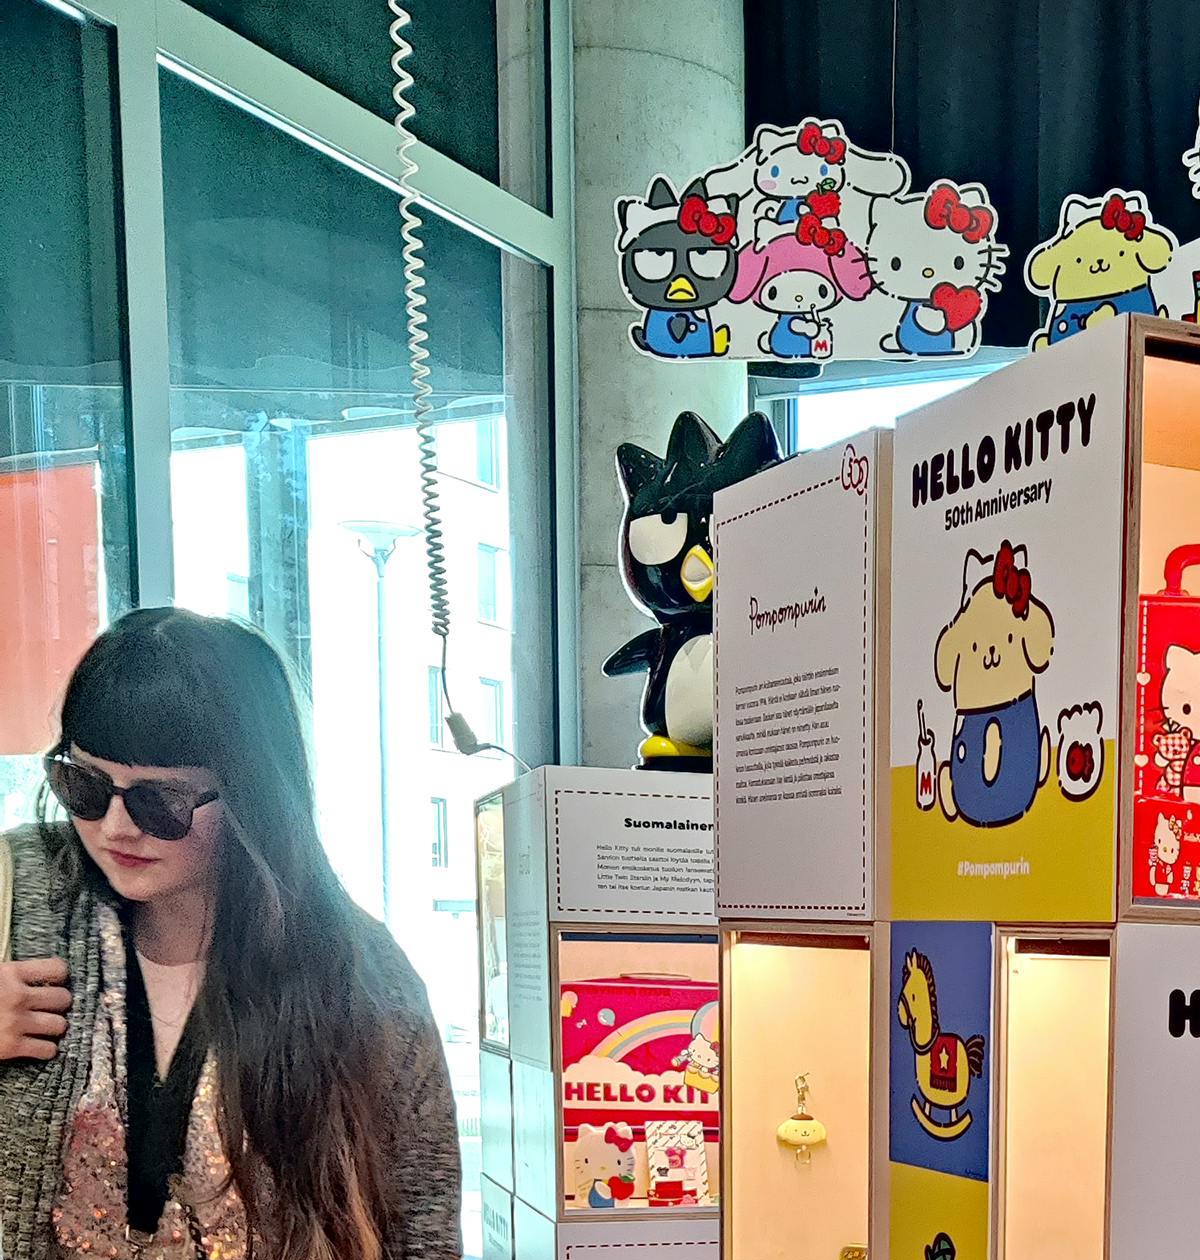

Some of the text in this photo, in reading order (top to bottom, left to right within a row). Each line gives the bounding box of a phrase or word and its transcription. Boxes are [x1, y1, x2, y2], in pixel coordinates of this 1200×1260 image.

[912, 393, 1096, 509] HELLO KITTY
[944, 478, 1053, 531] 50th Anniversary
[749, 586, 827, 635] Pompompurin
[957, 857, 1030, 880] #Pompompurin
[564, 1082, 656, 1103] HELLO
